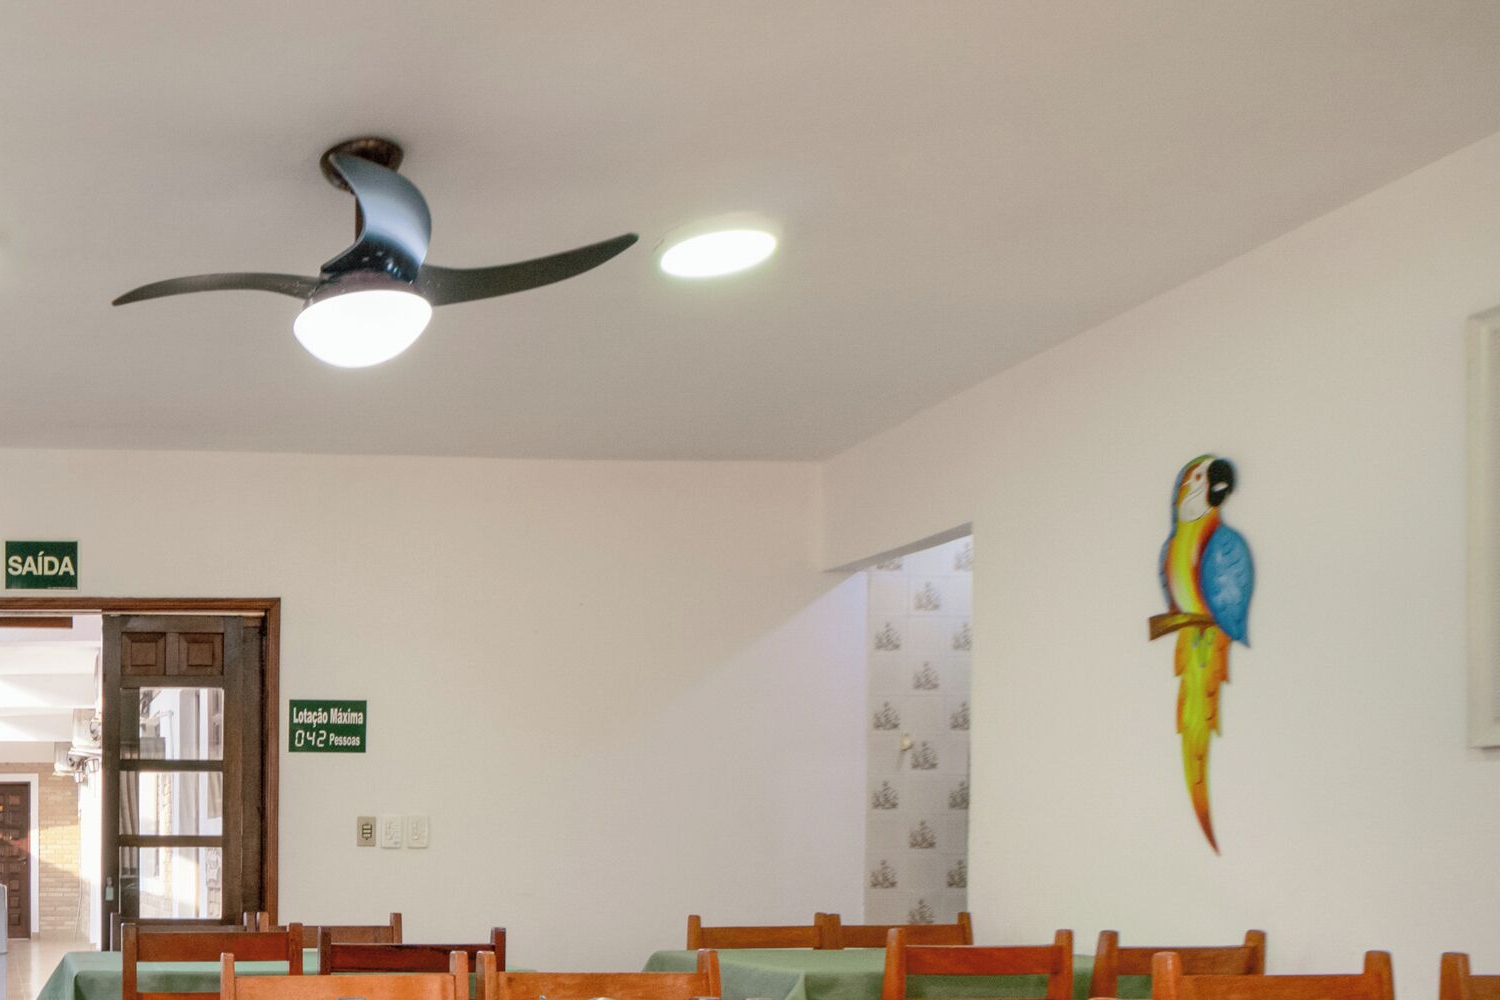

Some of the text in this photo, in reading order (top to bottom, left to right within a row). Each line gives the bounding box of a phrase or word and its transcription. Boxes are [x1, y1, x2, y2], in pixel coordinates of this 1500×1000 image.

[7, 551, 75, 576] SAÍDA
[293, 707, 363, 728] Lotação Máxima
[295, 729, 361, 747] 042 Pessoas
